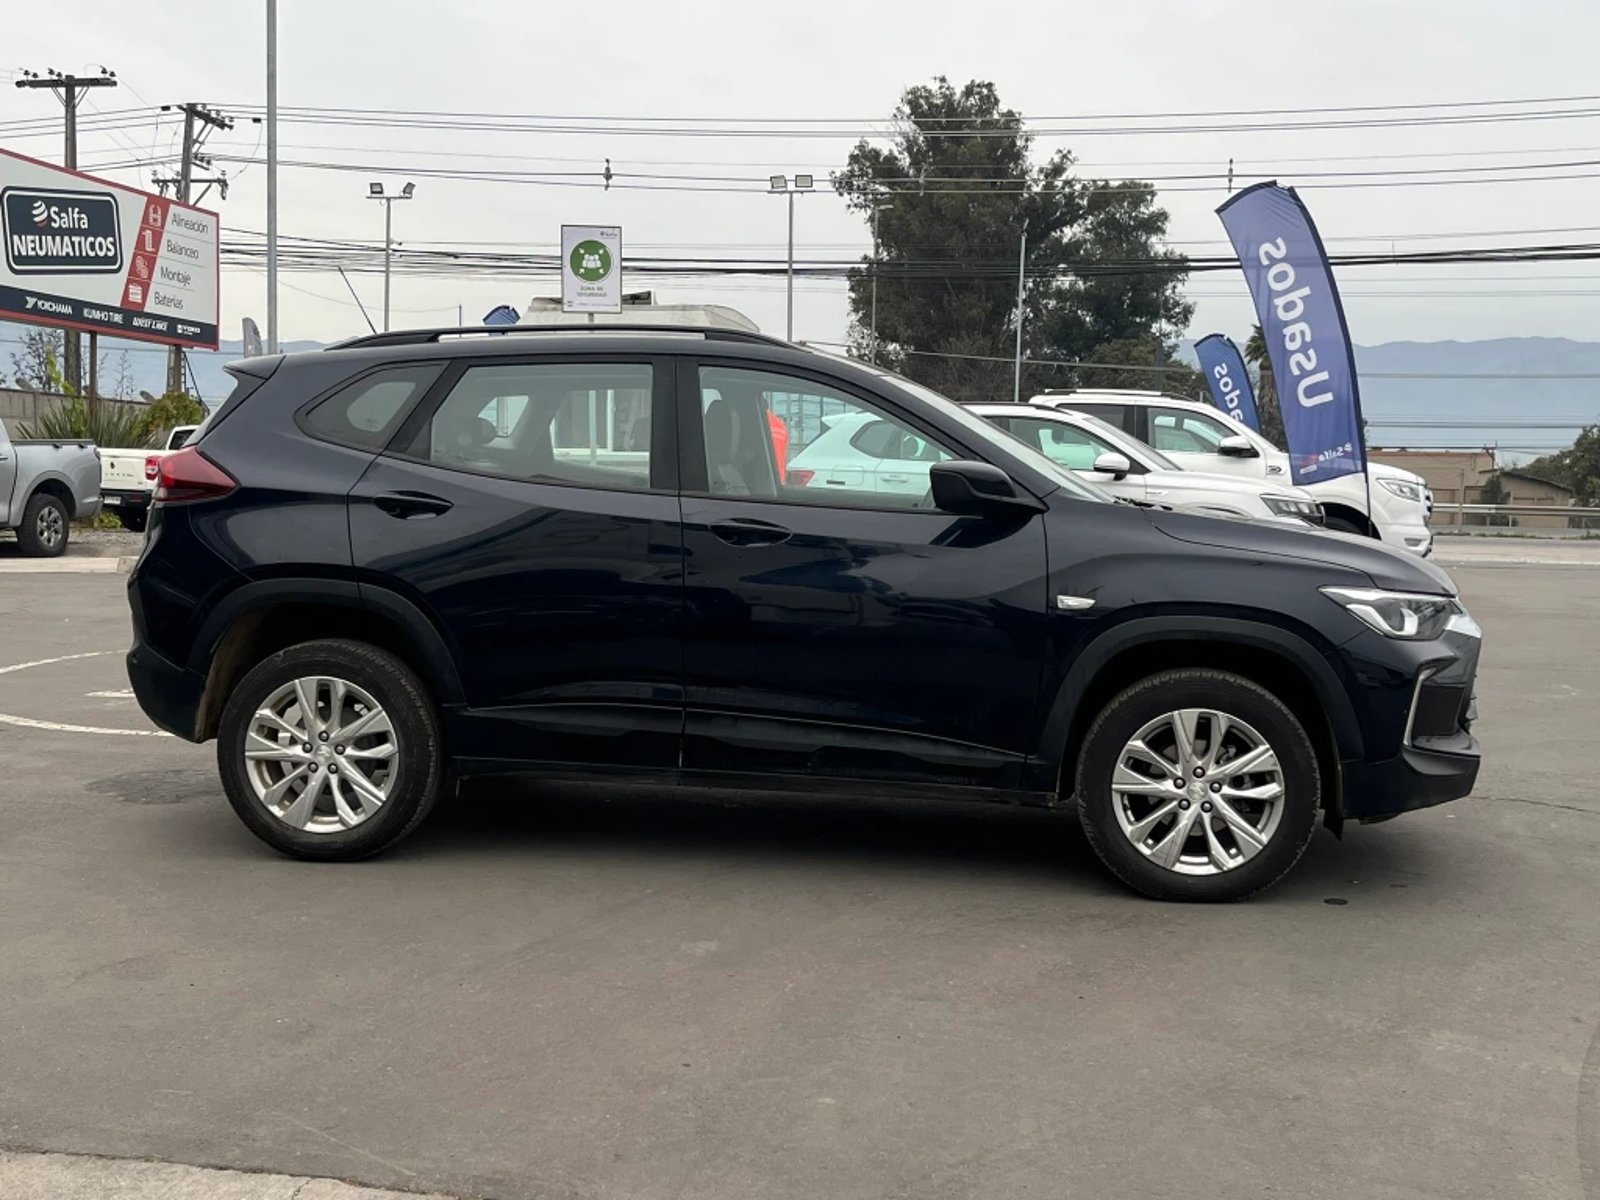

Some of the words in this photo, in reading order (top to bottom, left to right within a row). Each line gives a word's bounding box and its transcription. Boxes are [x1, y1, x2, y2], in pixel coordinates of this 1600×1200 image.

[50, 206, 88, 229] Salfa
[13, 234, 115, 257] NEUMATICOS
[167, 239, 199, 260] Balanceo
[161, 266, 191, 286] Montaje
[37, 300, 73, 315] YOKOHAMA
[83, 308, 108, 321] KUMHO
[109, 312, 123, 324] TIRE
